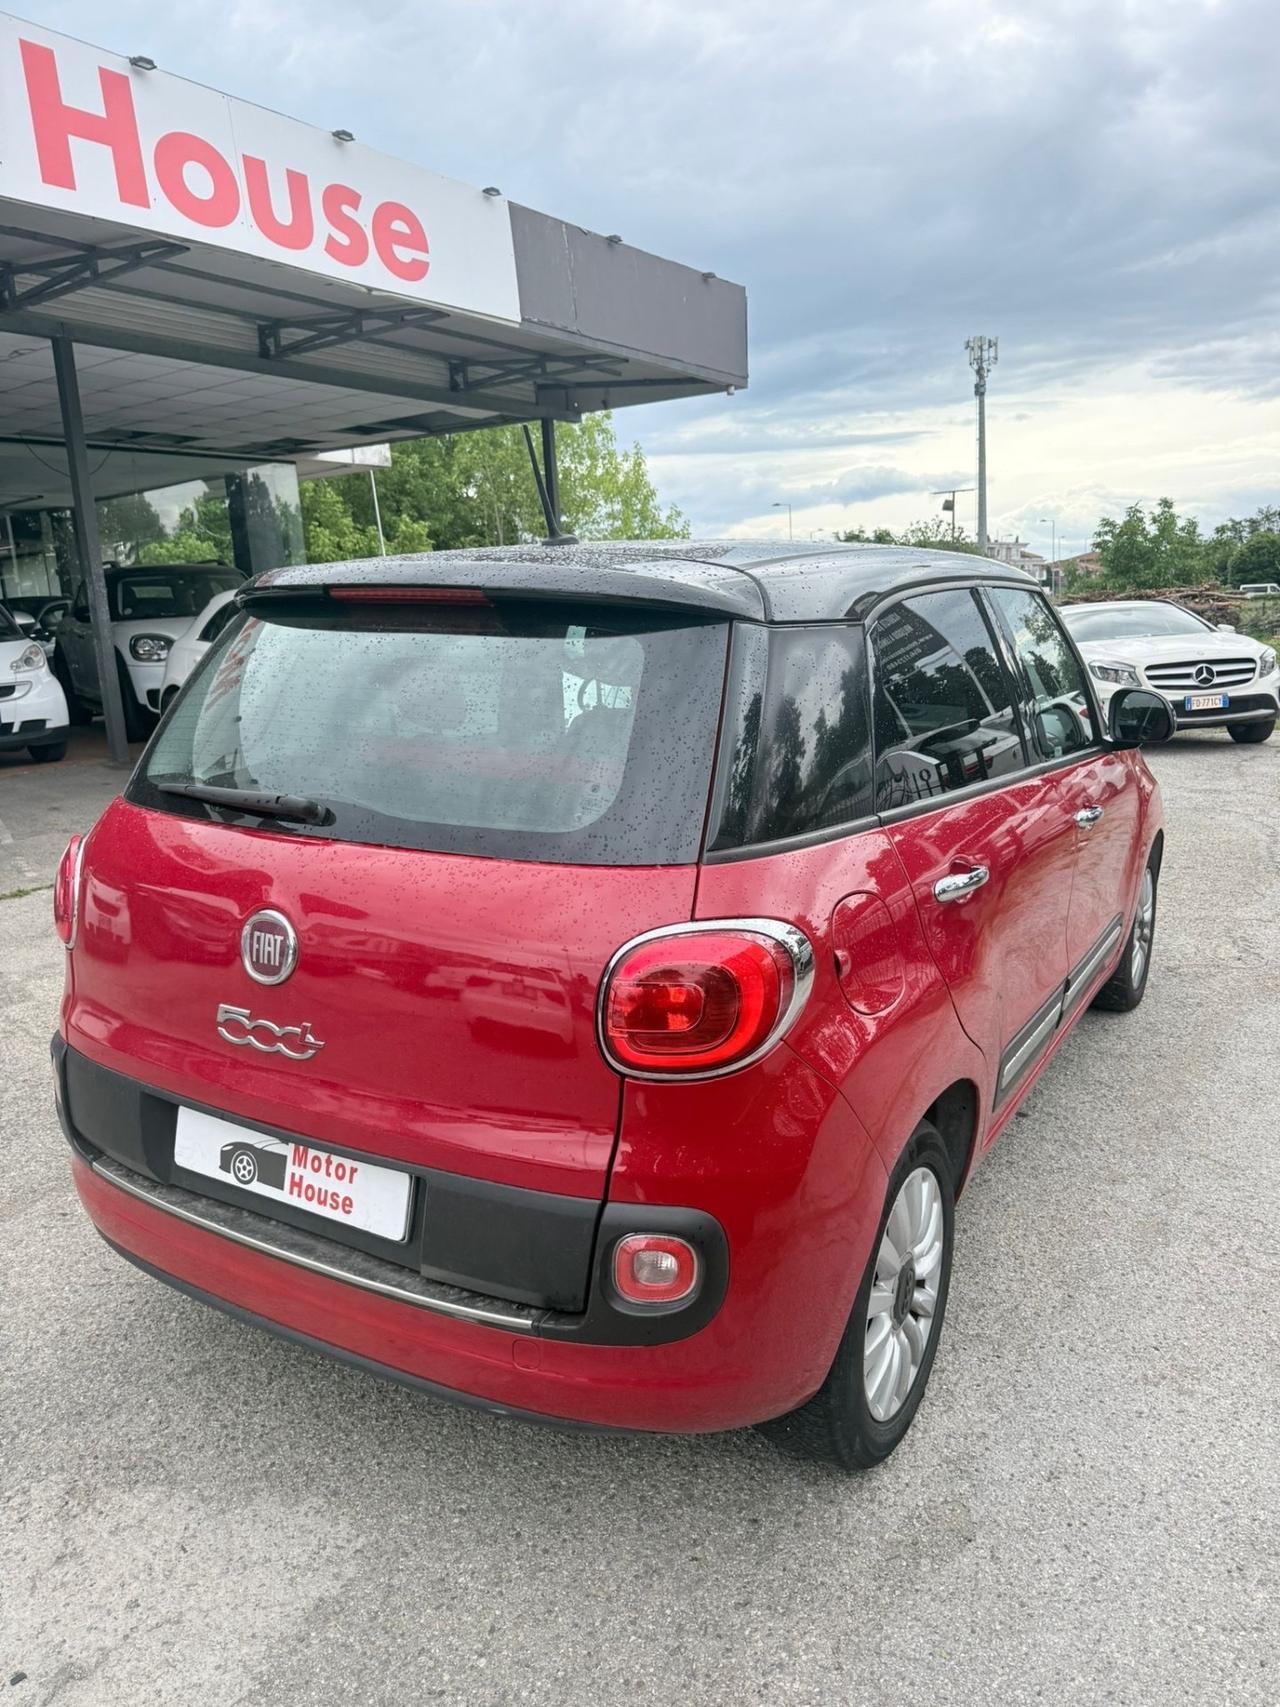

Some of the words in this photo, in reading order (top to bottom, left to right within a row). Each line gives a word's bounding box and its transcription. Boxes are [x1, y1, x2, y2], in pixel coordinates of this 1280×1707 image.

[19, 38, 430, 282] House
[253, 931, 285, 967] FIAT
[291, 1143, 359, 1185] Motor
[289, 1172, 354, 1215] House
